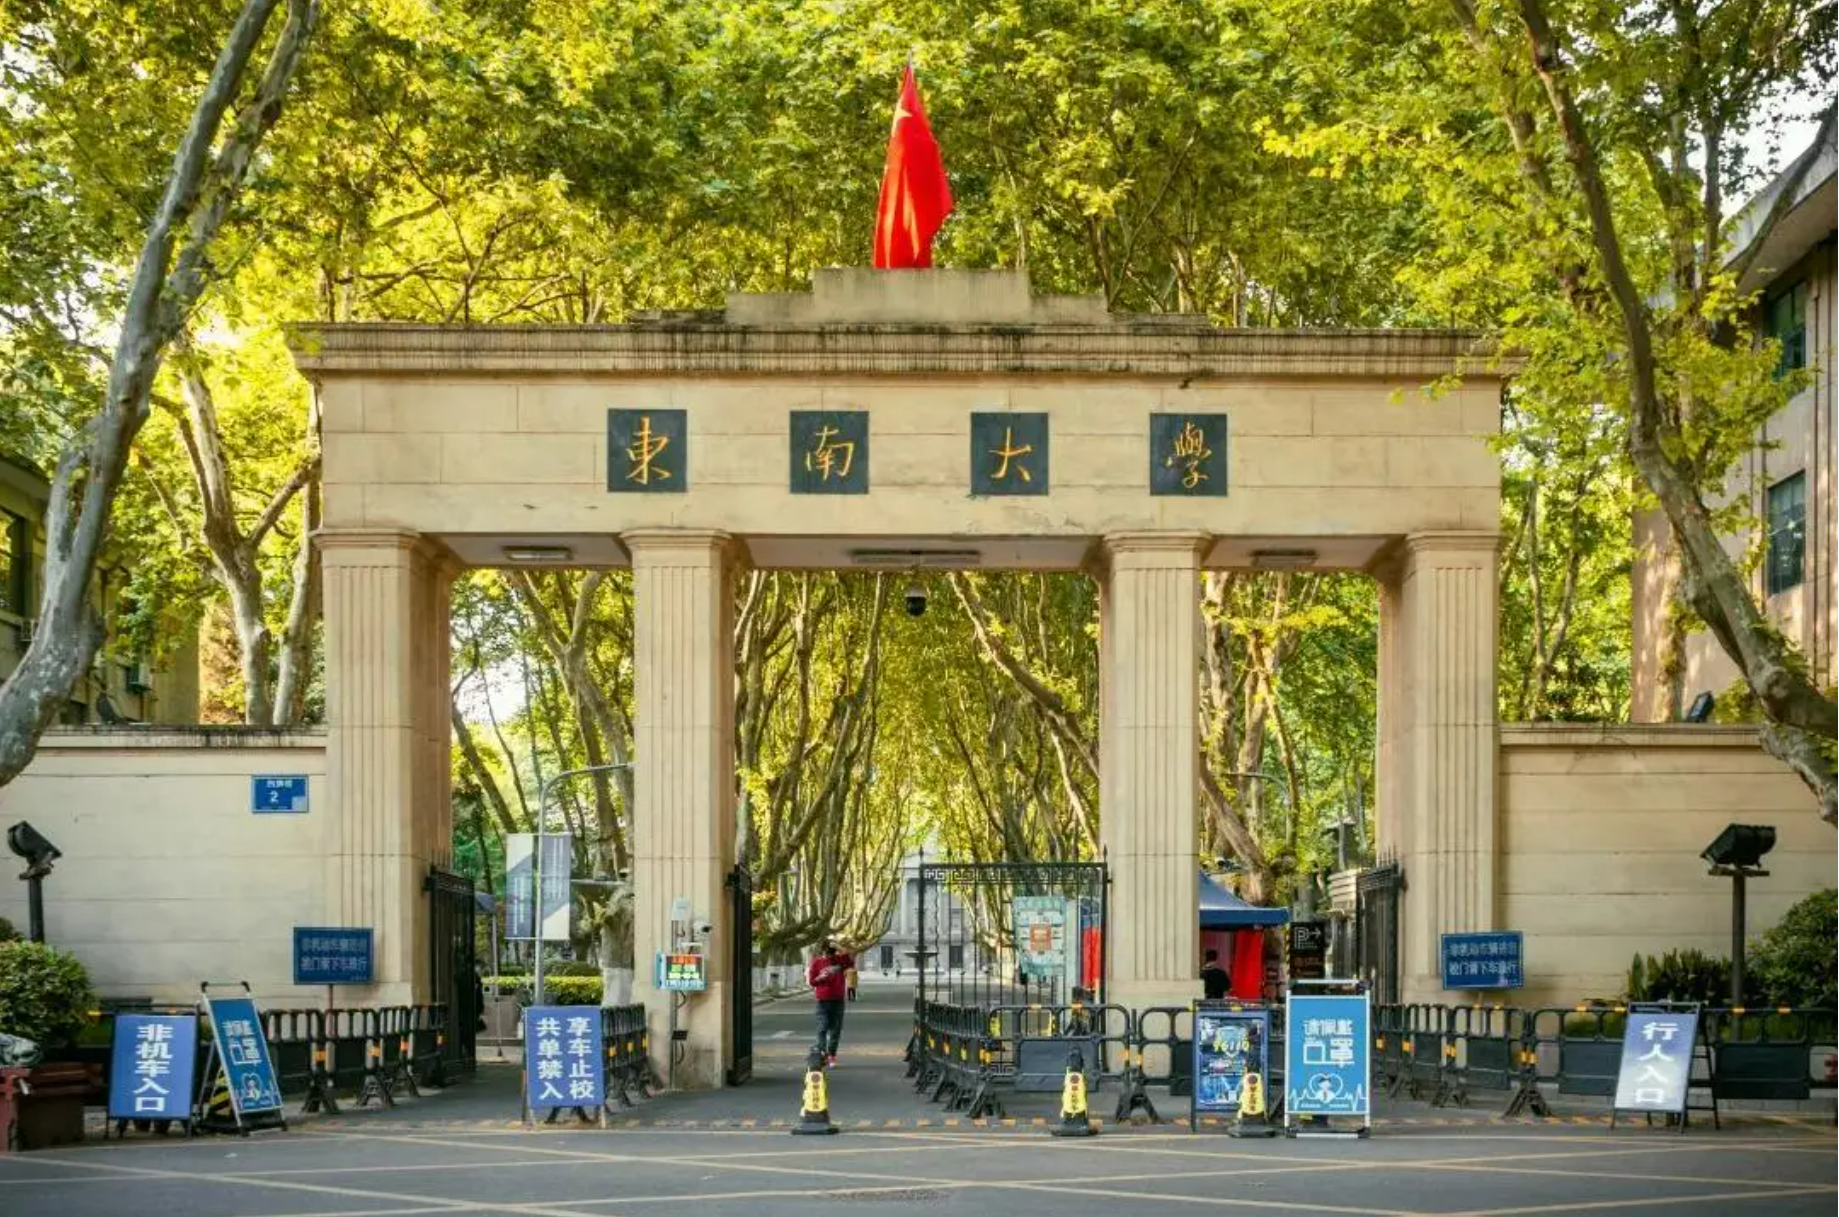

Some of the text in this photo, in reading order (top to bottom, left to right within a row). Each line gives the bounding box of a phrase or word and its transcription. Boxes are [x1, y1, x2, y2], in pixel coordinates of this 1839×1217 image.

[270, 790, 279, 804] 2
[1304, 1018, 1354, 1036] 请佩戴
[132, 1023, 174, 1112] 非机车入口
[1303, 1037, 1355, 1068] 口罩
[1635, 1021, 1680, 1104] 行人入口
